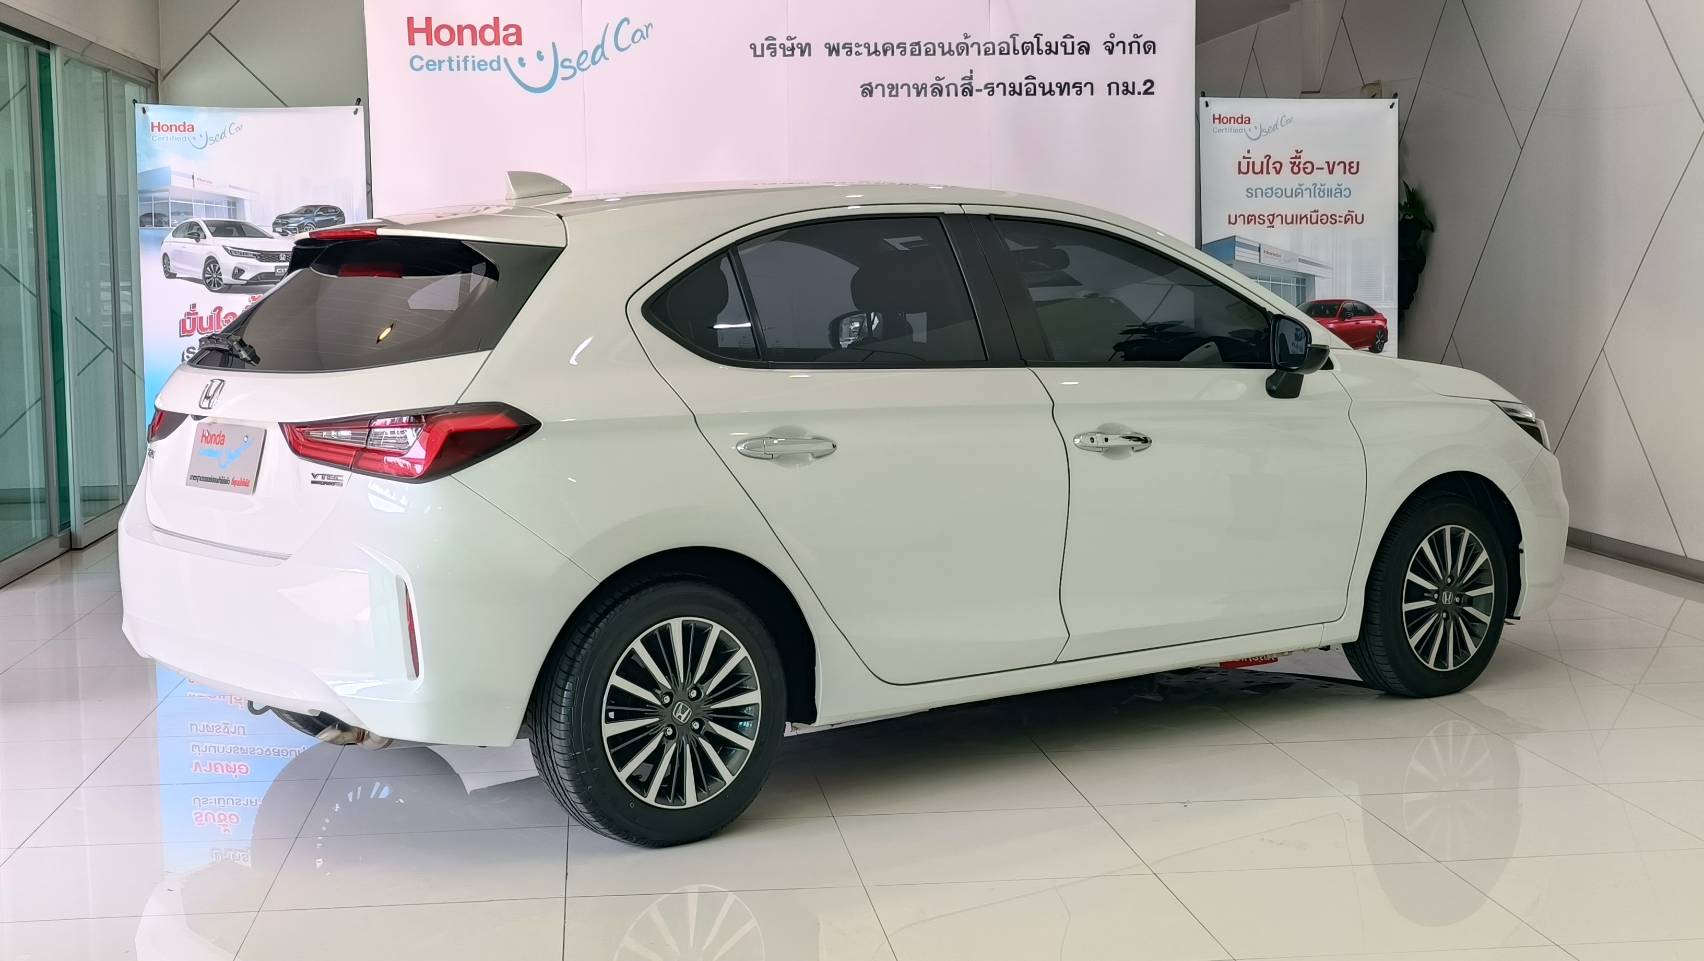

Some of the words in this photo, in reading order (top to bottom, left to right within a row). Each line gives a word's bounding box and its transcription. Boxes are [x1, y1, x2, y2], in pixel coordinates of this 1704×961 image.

[406, 16, 523, 46] Honda
[749, 35, 812, 58] บริษัท
[824, 32, 1091, 58] พระนครฮอนด้าออโตโมบิล
[1103, 33, 1156, 55] จำกัด
[409, 54, 502, 72] Certified
[503, 23, 609, 94] Used
[613, 17, 653, 52] Car
[860, 69, 1094, 97] สาขาหลักสี่-รามอินทรา
[1107, 78, 1155, 97] กม.2
[151, 121, 195, 133] Honda
[1212, 113, 1251, 125] Honda
[1237, 149, 1283, 176] มั่นใจ
[1289, 149, 1360, 176] ซื้อ-ขาย
[1246, 183, 1352, 199] รถฮอนด้าใช้แล้ว
[1228, 209, 1365, 229] มาตรฐานเหนือระดับ
[200, 429, 226, 446] Honda
[311, 472, 344, 482] VTEC
